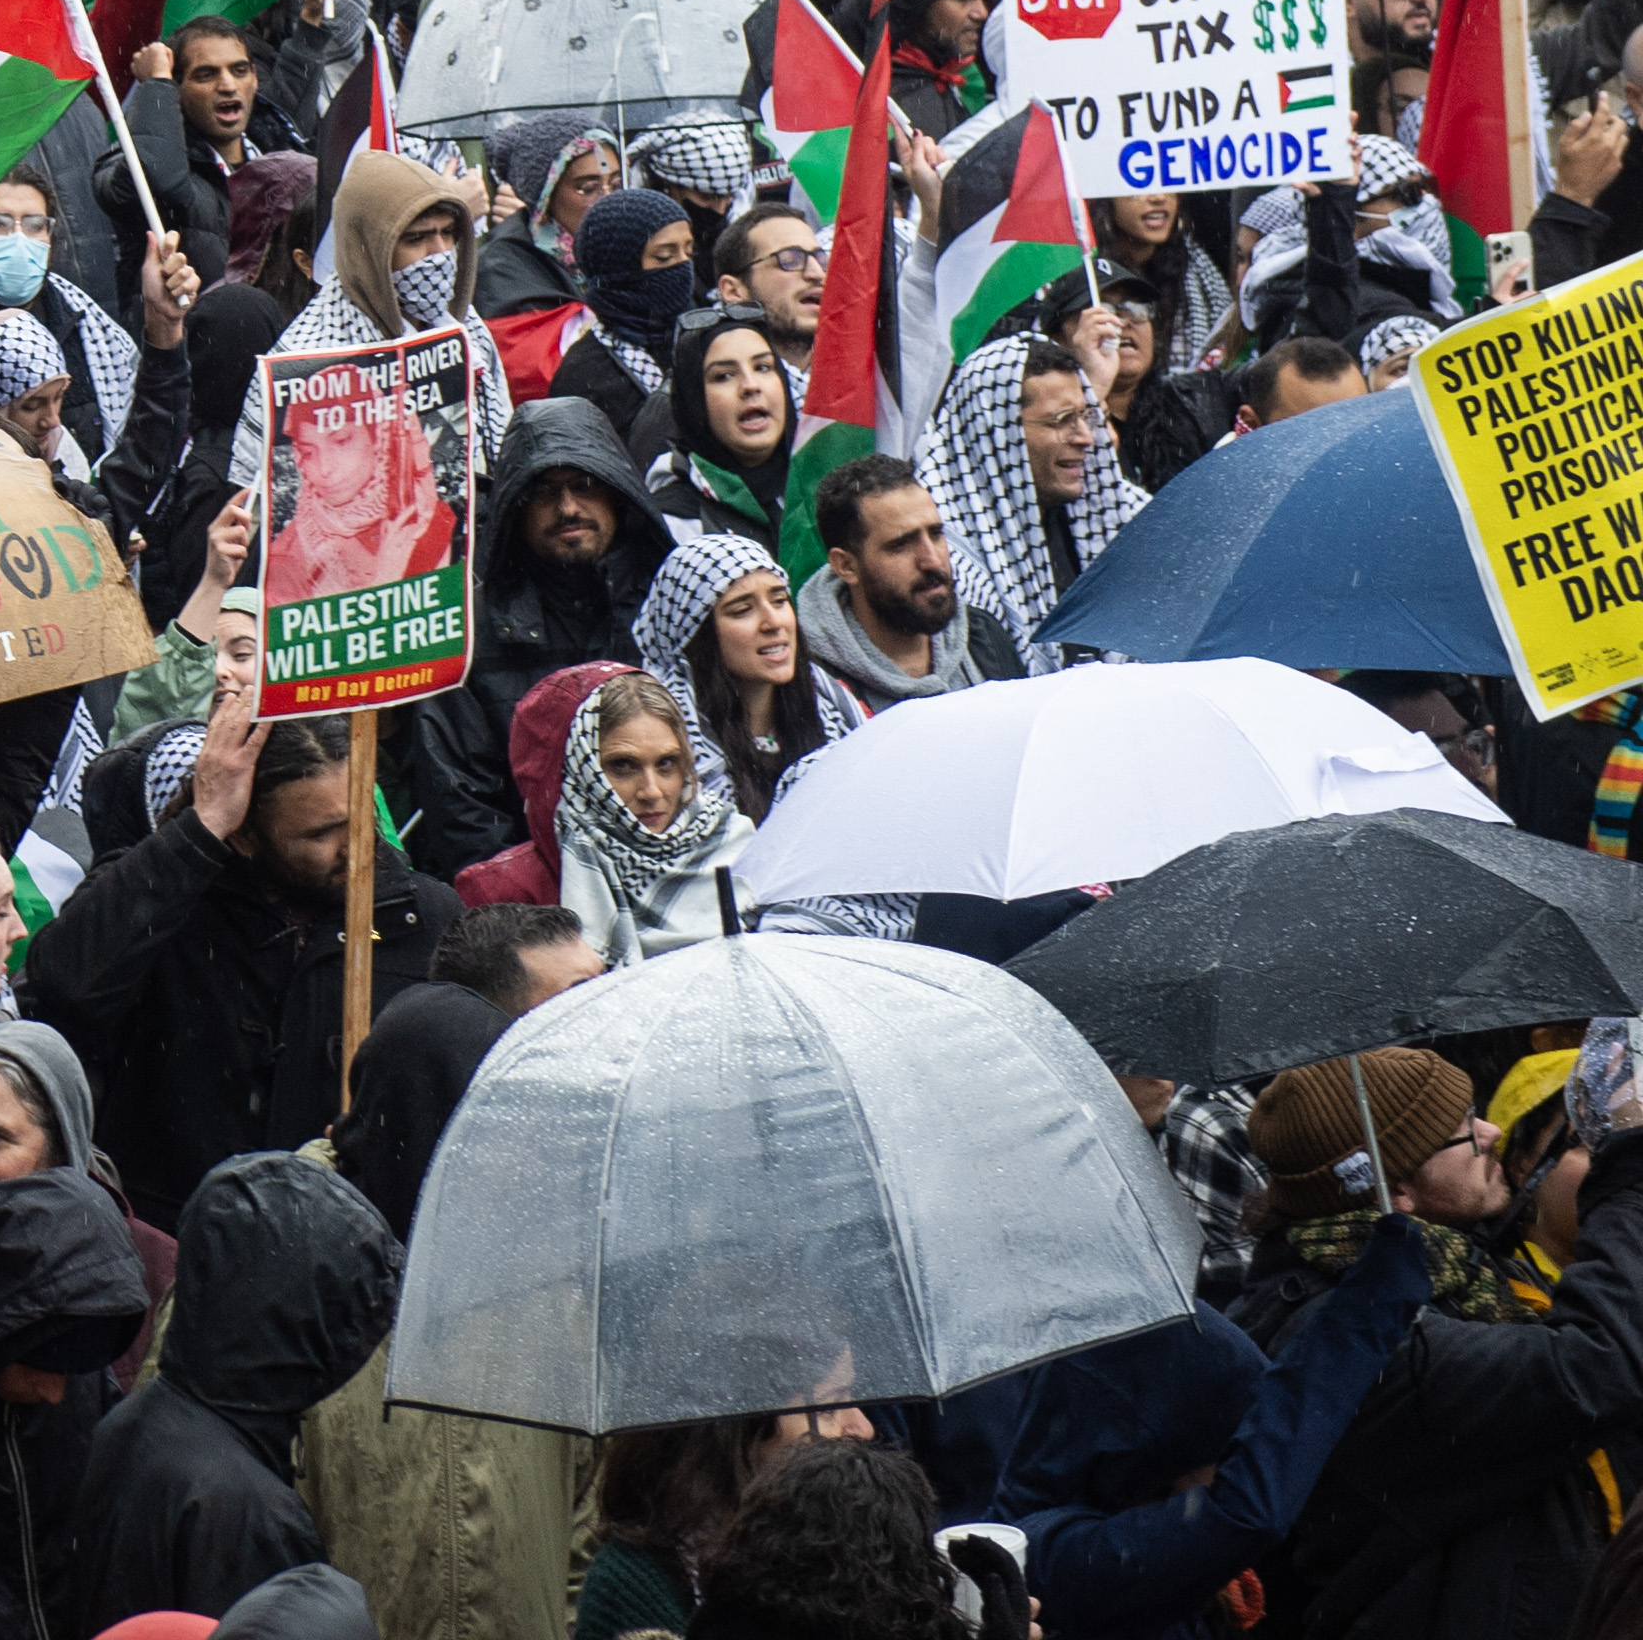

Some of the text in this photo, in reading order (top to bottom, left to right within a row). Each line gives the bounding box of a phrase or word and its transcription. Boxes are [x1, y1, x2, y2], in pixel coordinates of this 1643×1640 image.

[1136, 10, 1235, 63] TAX
[1046, 79, 1261, 141] TO FUND A
[1119, 127, 1331, 188] GENOCIDE
[273, 338, 464, 408] FROM THE RIVER
[1435, 330, 1523, 394] STOP
[1457, 326, 1643, 437] PALESTINIA
[314, 381, 443, 434] TO THE SEA
[1495, 378, 1643, 474] POLITICA
[1500, 424, 1643, 520] PRISONE
[1502, 491, 1643, 589] FREE W
[282, 574, 441, 641] PALESTINE
[1561, 554, 1643, 624] DAQ
[266, 605, 464, 682] WILL BE FREE
[295, 667, 433, 704] May Day Detroit
